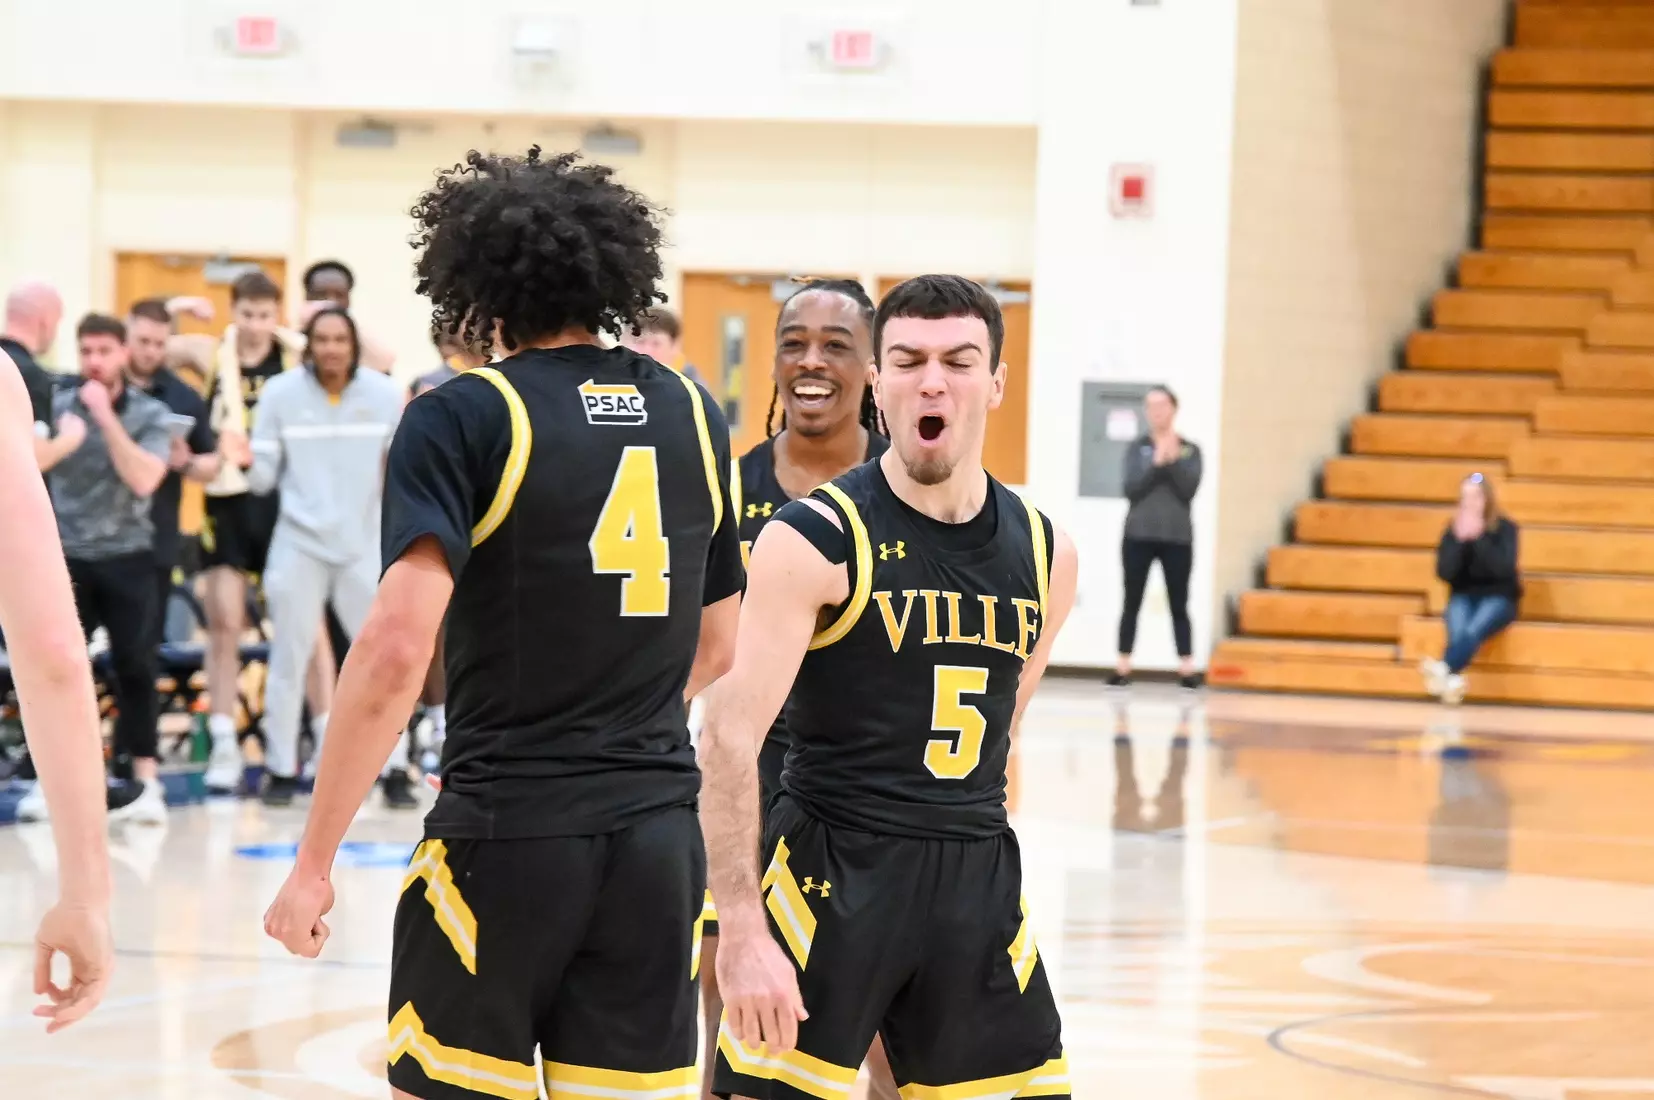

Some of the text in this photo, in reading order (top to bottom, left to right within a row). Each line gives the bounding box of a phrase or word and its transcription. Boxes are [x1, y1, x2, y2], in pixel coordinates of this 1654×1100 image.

[585, 395, 642, 413] PSAC
[588, 445, 670, 617] 4
[872, 589, 1040, 662] VILLE
[923, 664, 989, 780] 5
